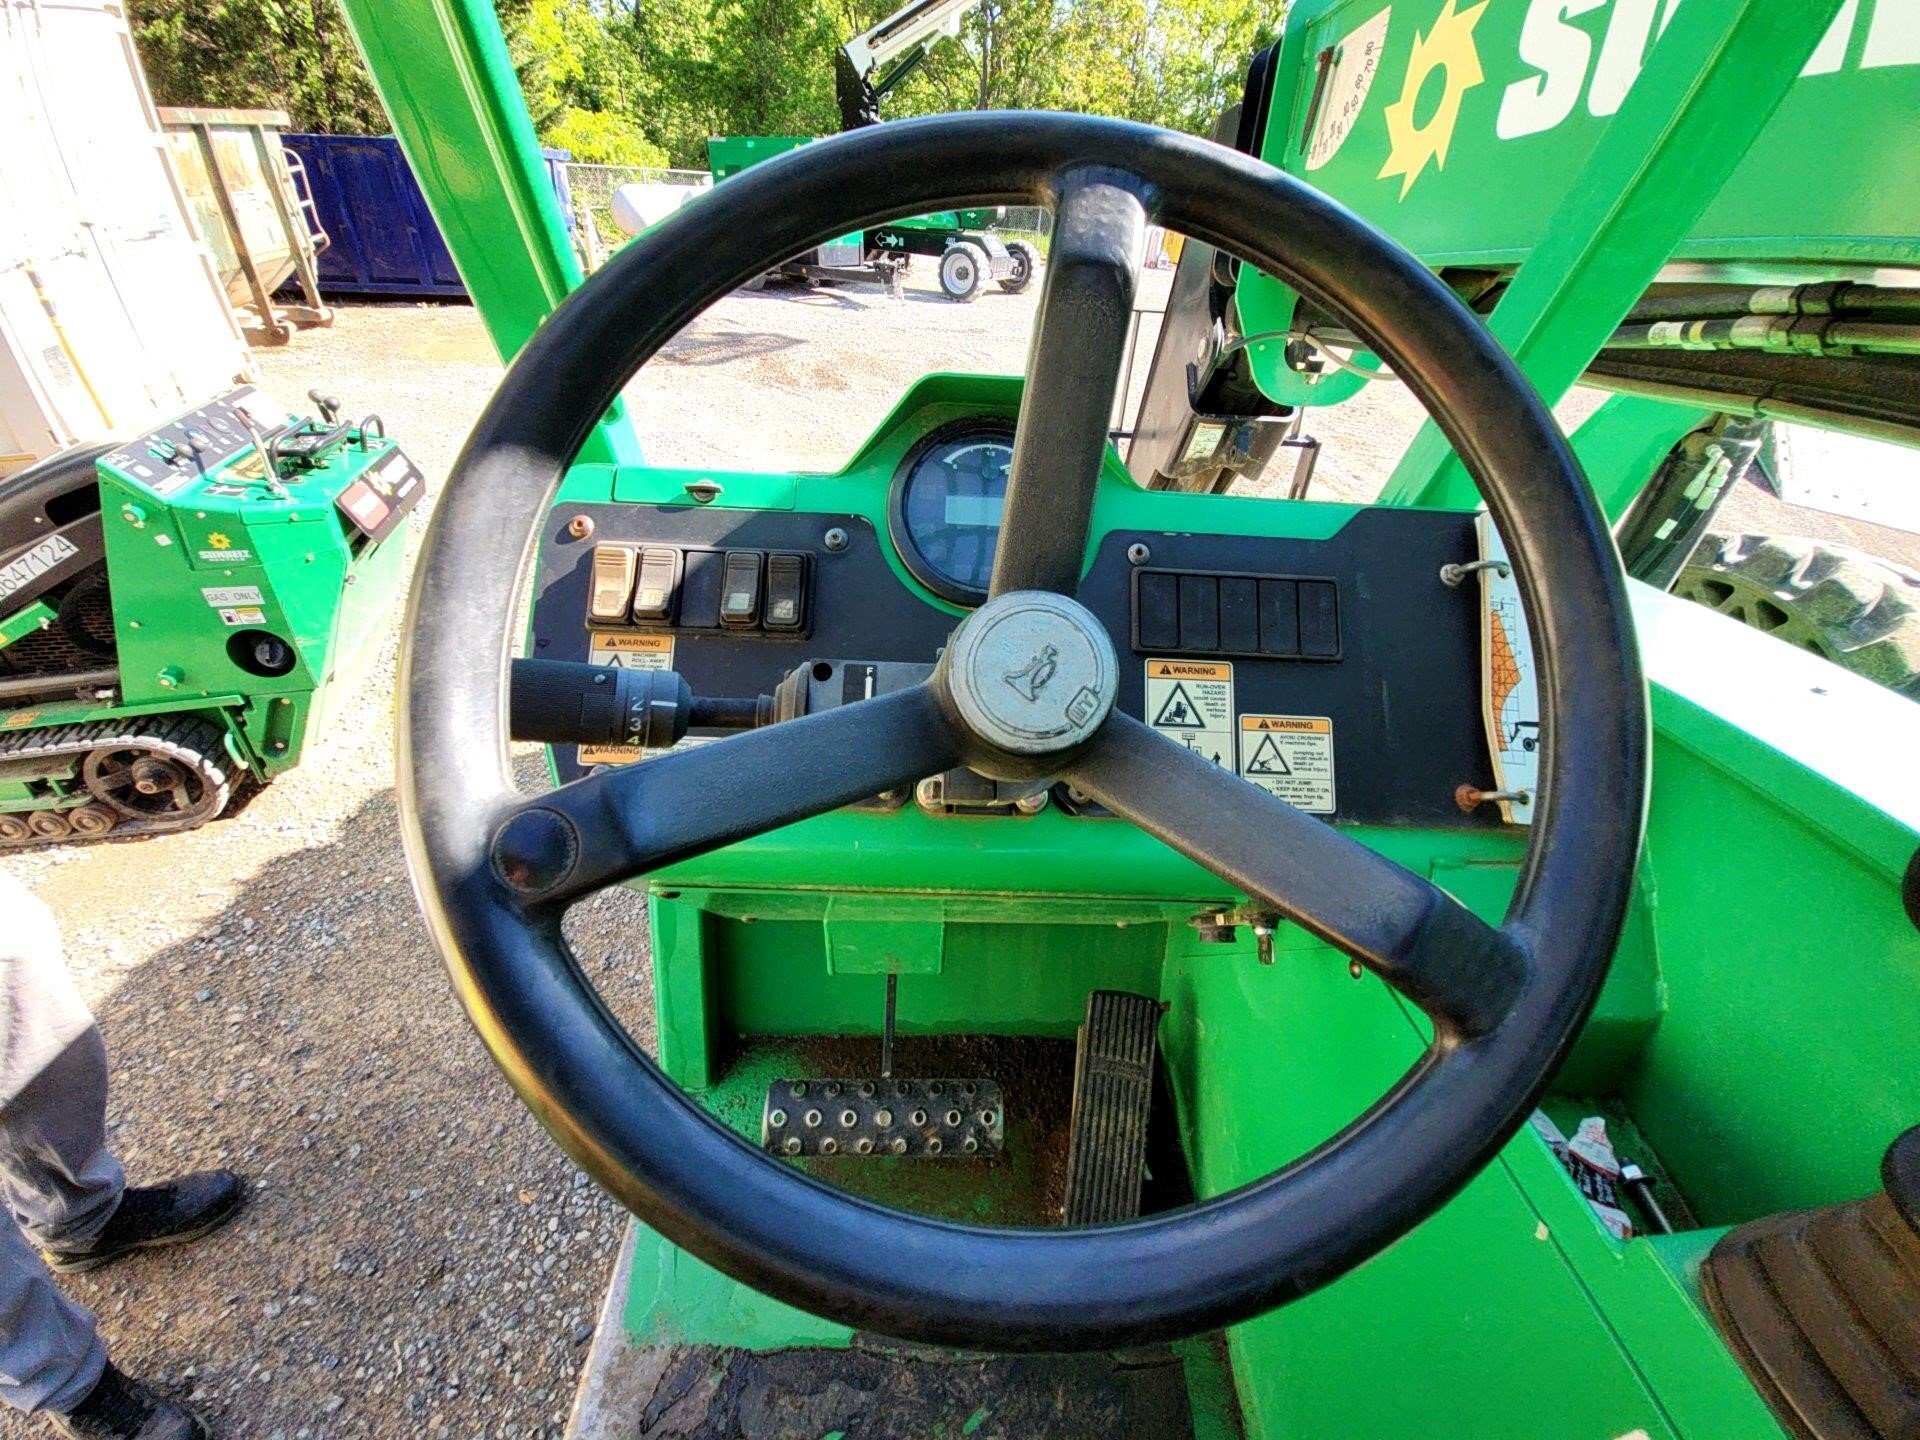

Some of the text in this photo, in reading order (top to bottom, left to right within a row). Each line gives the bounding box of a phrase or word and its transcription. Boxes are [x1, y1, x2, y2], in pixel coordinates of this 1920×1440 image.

[1364, 59, 1374, 73] 70
[206, 591, 261, 602] GAS ONLY
[618, 638, 661, 648] WARNING
[866, 666, 874, 676] F
[1172, 666, 1217, 676] WARNING
[631, 697, 644, 711] 2
[629, 717, 641, 731] 3
[1271, 720, 1313, 729] WARNING
[595, 745, 640, 755] WARNING
